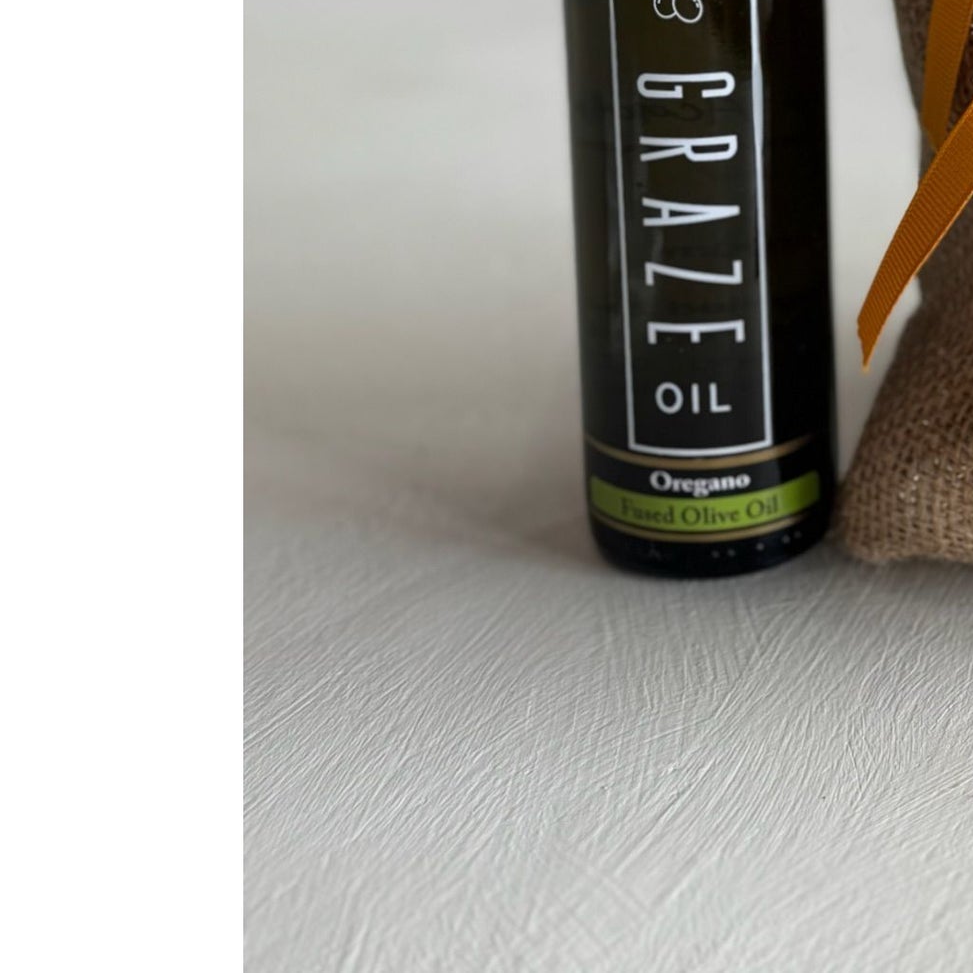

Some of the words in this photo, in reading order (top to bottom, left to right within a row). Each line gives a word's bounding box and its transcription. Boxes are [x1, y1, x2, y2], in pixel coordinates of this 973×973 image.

[636, 70, 746, 345] GRAZE
[654, 381, 732, 415] OIL
[649, 469, 751, 498] Oregano
[620, 498, 676, 526] Fused
[680, 504, 740, 525] Olive
[745, 495, 780, 519] Oil
